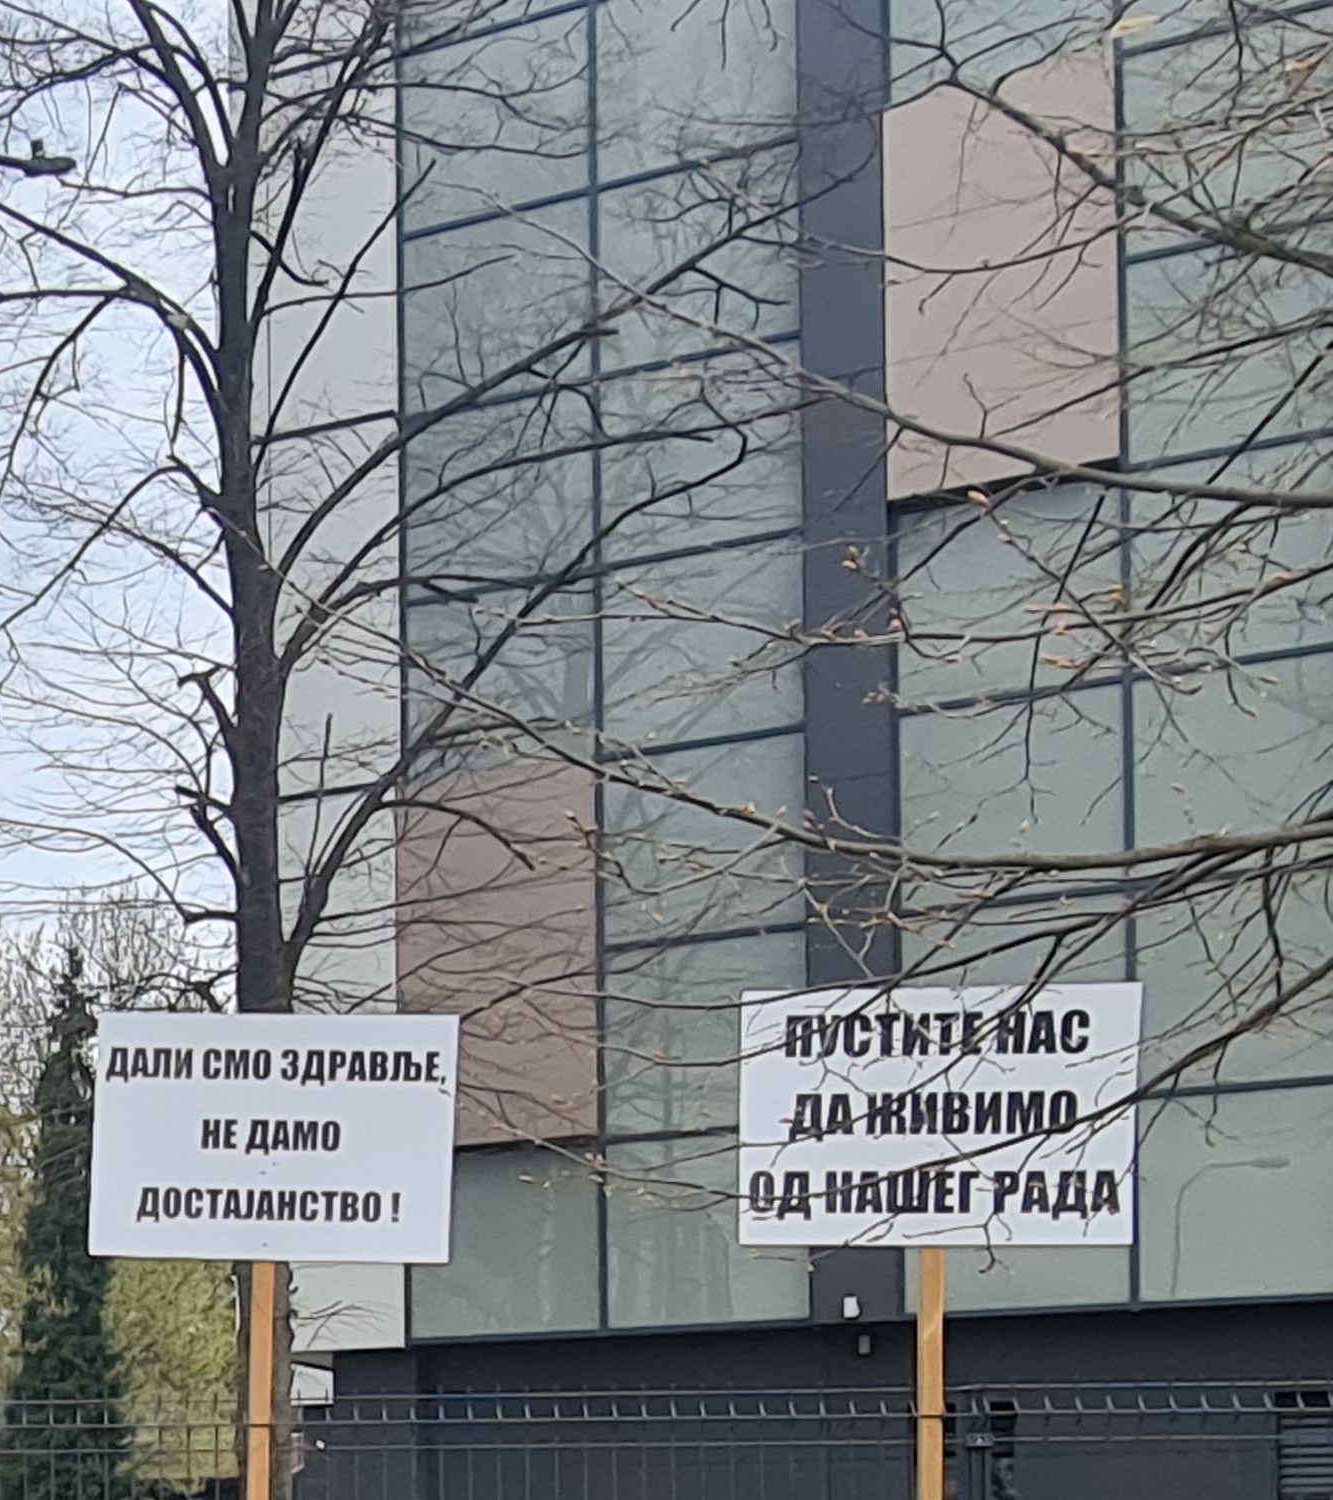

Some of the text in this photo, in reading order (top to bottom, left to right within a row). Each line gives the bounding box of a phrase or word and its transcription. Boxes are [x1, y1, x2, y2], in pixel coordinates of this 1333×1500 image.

[785, 1009, 1090, 1057] ПУСТИТЕ НАС
[105, 1047, 446, 1086] ДАЛИ СМО ЗДРАВЉЕ,
[201, 1119, 341, 1155] НЕ ДАМО
[789, 1090, 1078, 1141] ДА ЖИВИМО
[136, 1187, 381, 1223] ДОСТАЈАНСТВО
[749, 1170, 1121, 1220] ОД НАШЕГ РАДА
